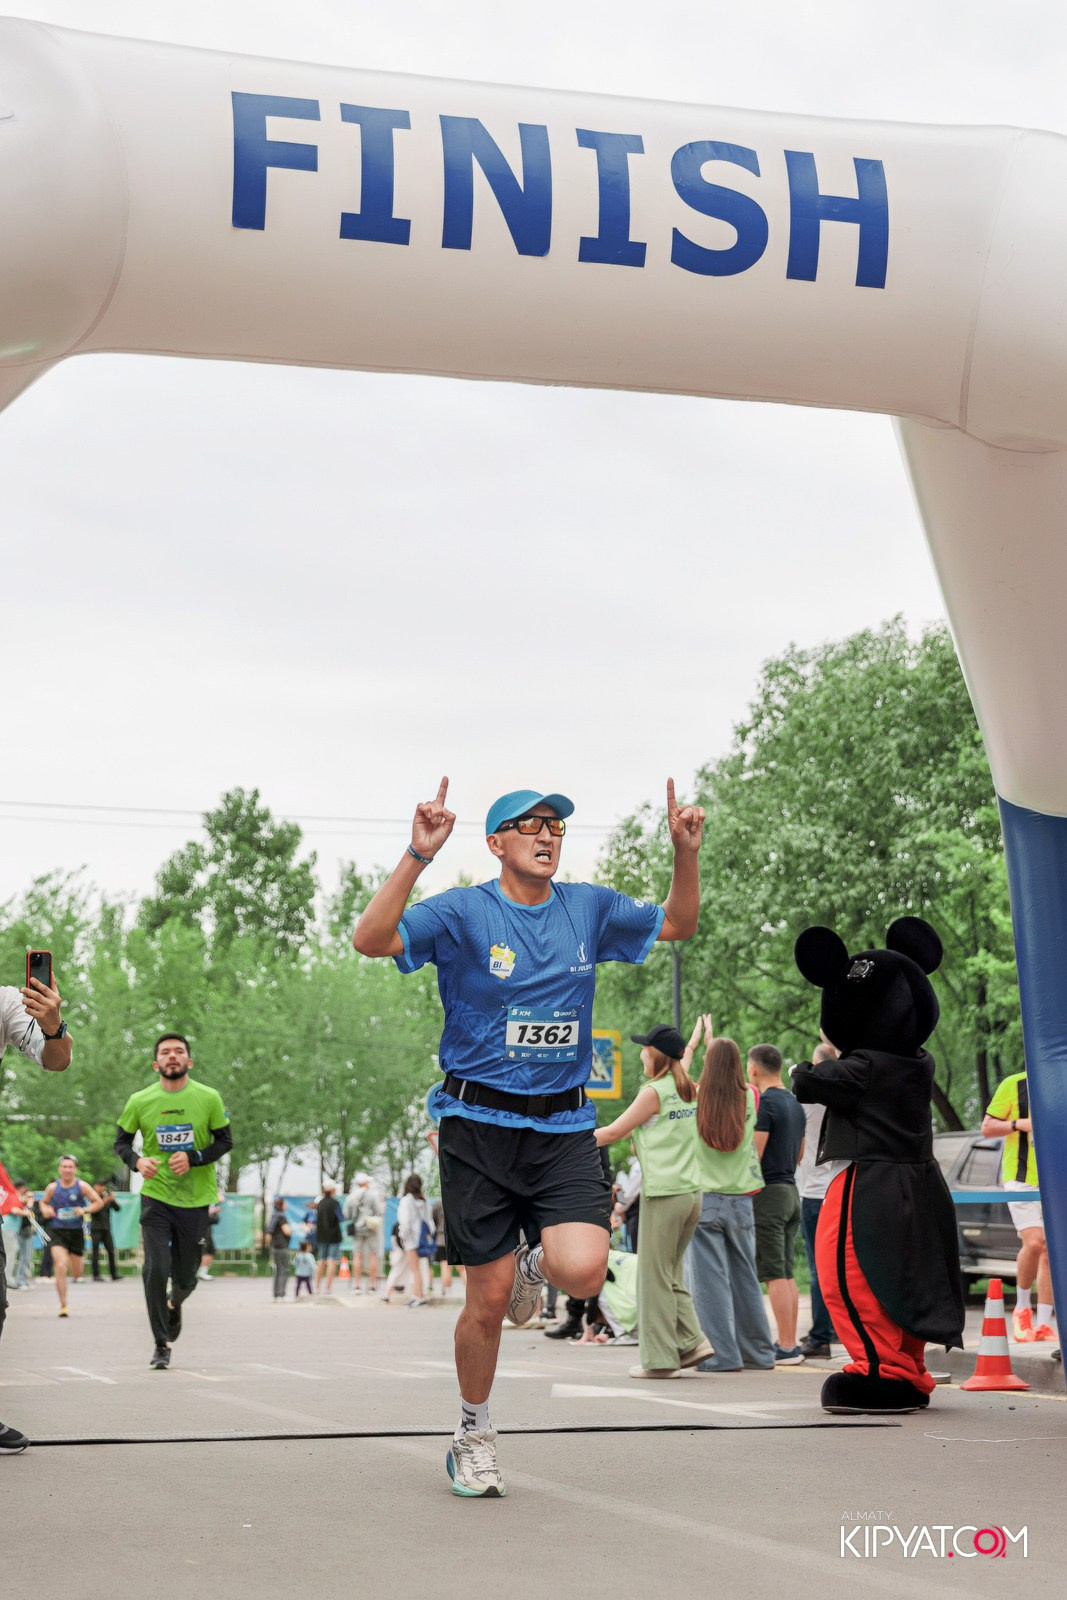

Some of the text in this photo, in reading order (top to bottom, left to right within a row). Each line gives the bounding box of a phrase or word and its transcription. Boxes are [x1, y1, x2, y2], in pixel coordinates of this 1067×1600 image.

[231, 92, 889, 289] FINISH
[511, 1008, 518, 1016] 5
[517, 1024, 573, 1045] 1362
[161, 1133, 189, 1143] 1847
